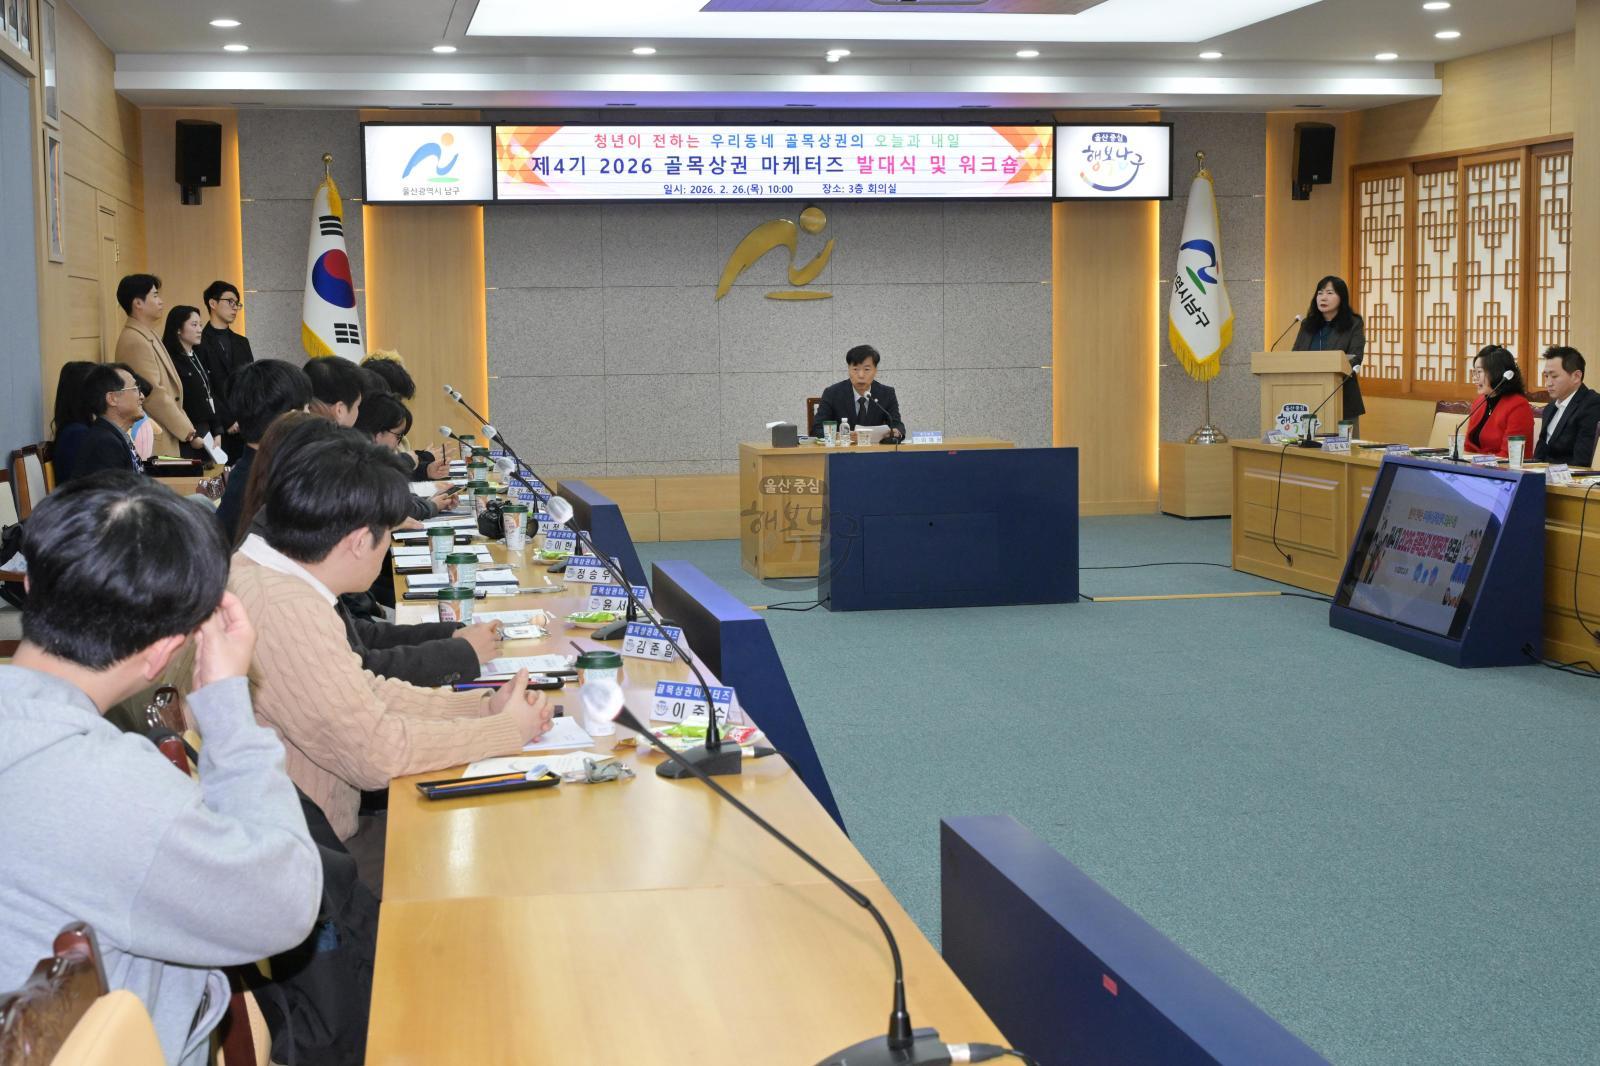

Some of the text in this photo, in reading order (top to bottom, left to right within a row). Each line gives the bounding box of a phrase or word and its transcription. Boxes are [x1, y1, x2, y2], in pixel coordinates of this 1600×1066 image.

[594, 133, 960, 149] 청년이 전하는 우리동네 골목상권의 오늘과 내일
[531, 154, 1019, 176] 제4기 2026 골목상권 마케터즈 발대식 및 워크숍
[402, 186, 460, 196] 울산광역시 남구
[663, 183, 897, 196] 일시: 2026. 2. 26.(목) 10:00 장소: 3층 회의실
[656, 683, 731, 701] 골목상권마터즈
